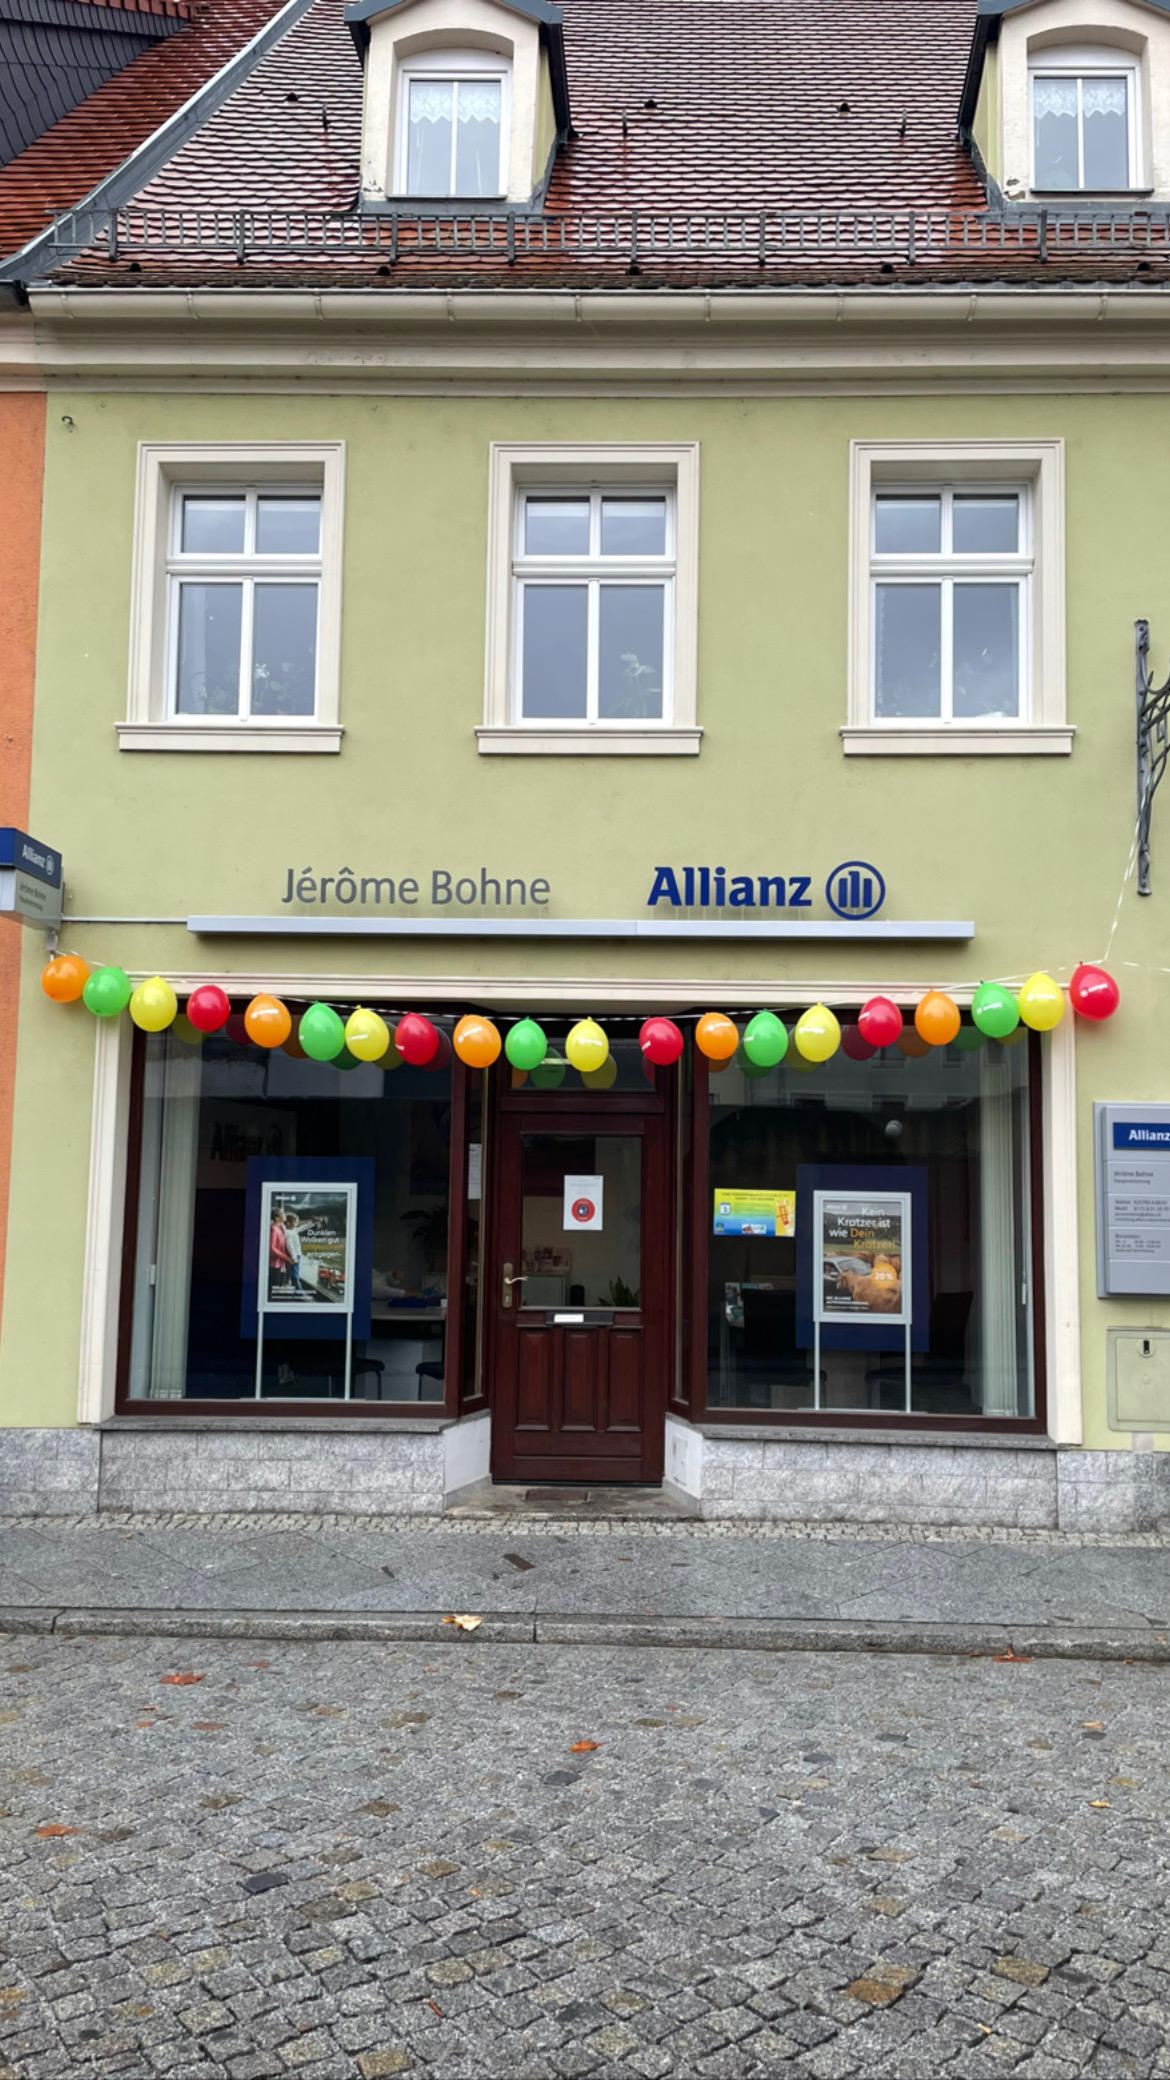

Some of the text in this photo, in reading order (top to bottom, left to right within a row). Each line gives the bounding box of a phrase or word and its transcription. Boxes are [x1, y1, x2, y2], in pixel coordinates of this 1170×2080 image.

[281, 866, 550, 906] Jérôme Bohne
[647, 866, 812, 907] Allianz
[1128, 1129, 1170, 1141] Allianz
[861, 1207, 885, 1217] Kein
[837, 1217, 891, 1229] Kratzer ist
[828, 1227, 875, 1239] wie Dein
